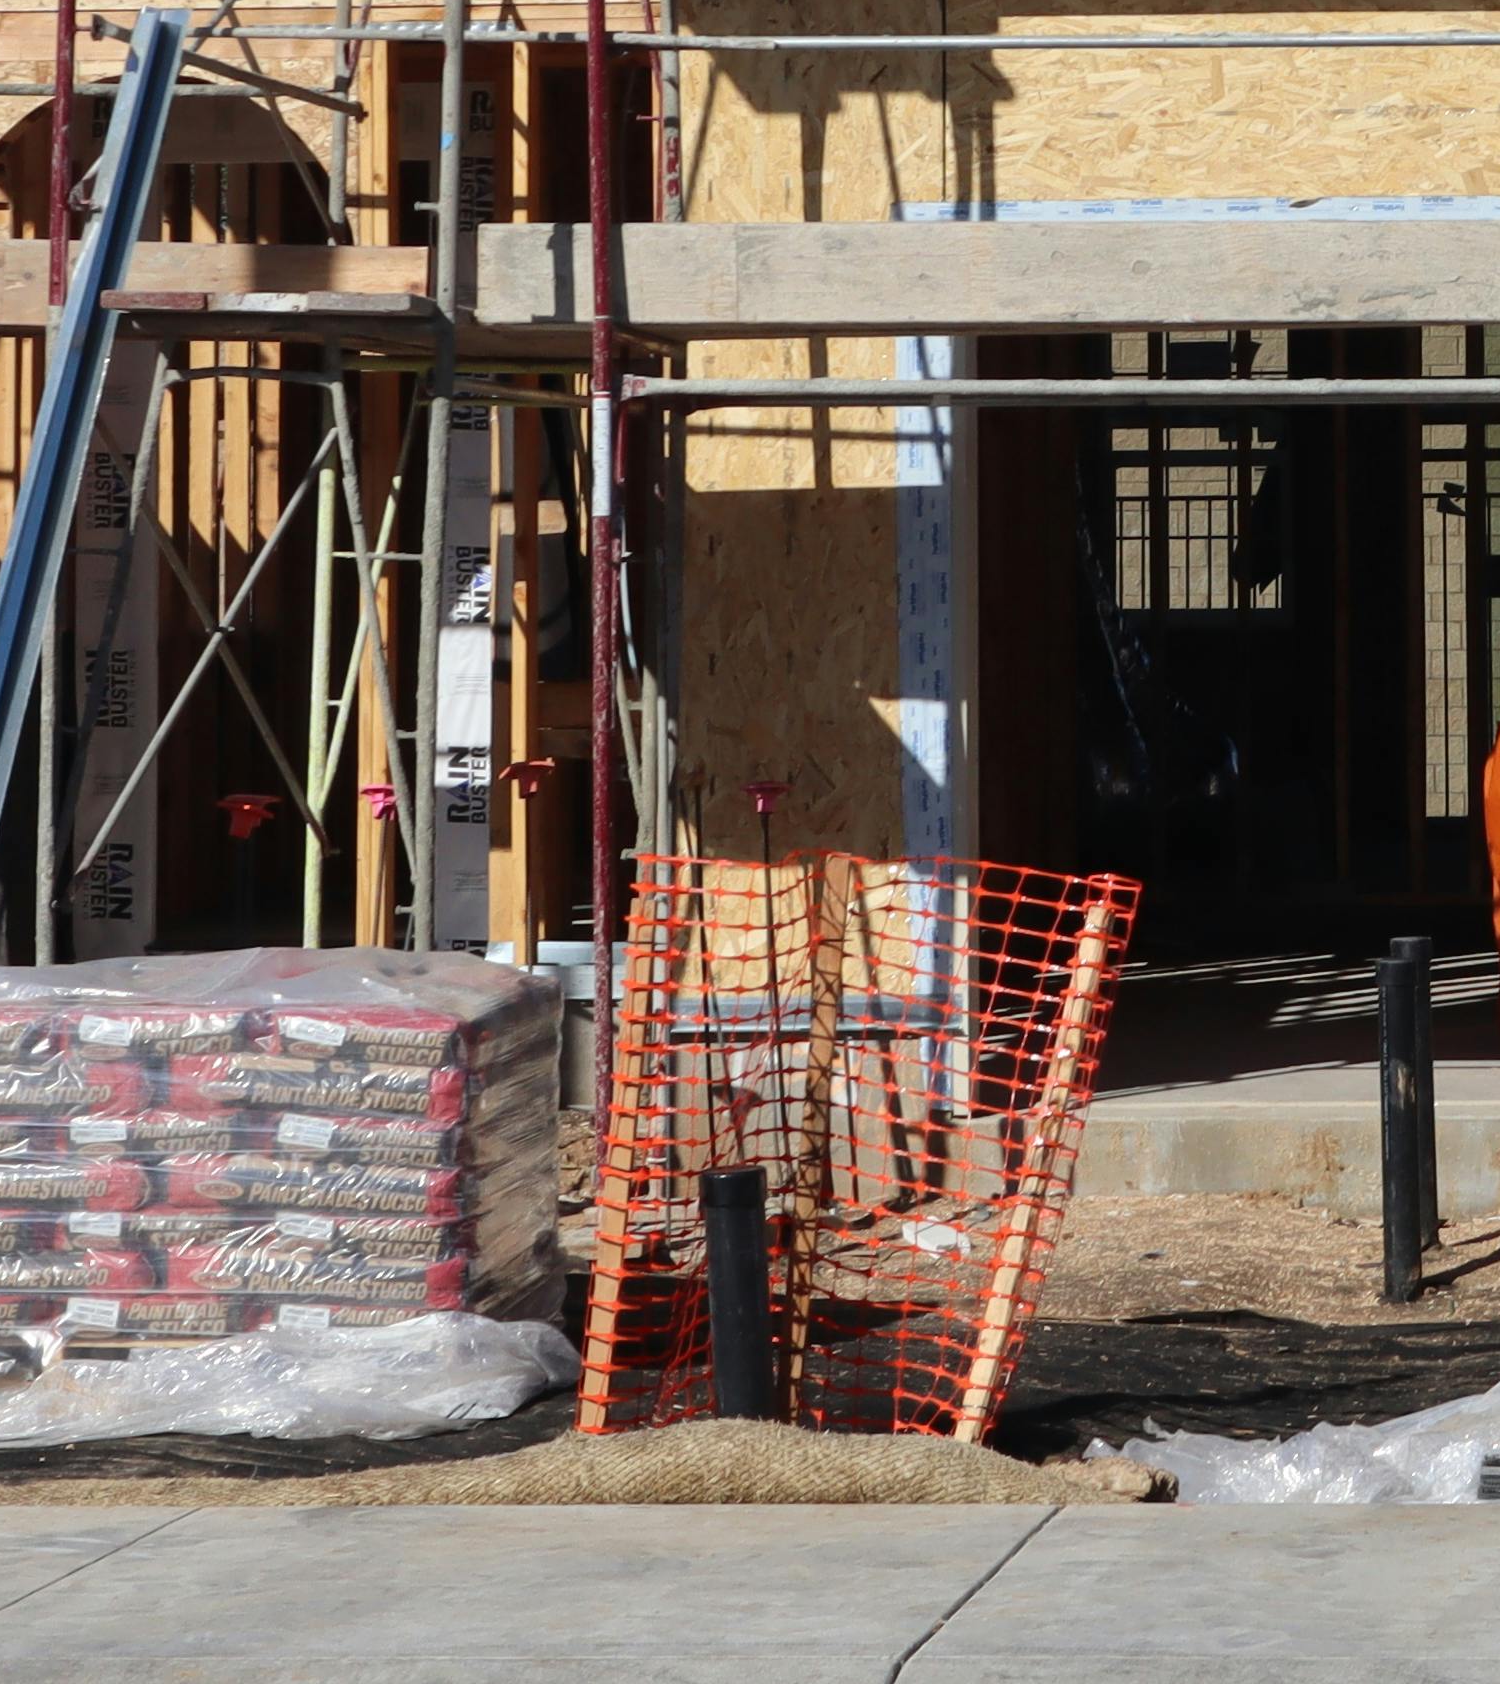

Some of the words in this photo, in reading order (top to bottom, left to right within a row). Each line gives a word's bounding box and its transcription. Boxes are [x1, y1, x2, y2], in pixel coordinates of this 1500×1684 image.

[94, 452, 111, 529] BUSTER
[455, 546, 472, 624] BUSTER
[111, 650, 128, 728] BUSTER
[447, 747, 469, 823] RAIN
[470, 746, 488, 823] BUSTER
[108, 843, 134, 920] RAIN
[155, 1034, 233, 1056] STUCCO
[362, 1045, 443, 1065] STUCCO
[358, 1146, 438, 1166] STUCCO
[361, 1241, 441, 1259] STUCCO
